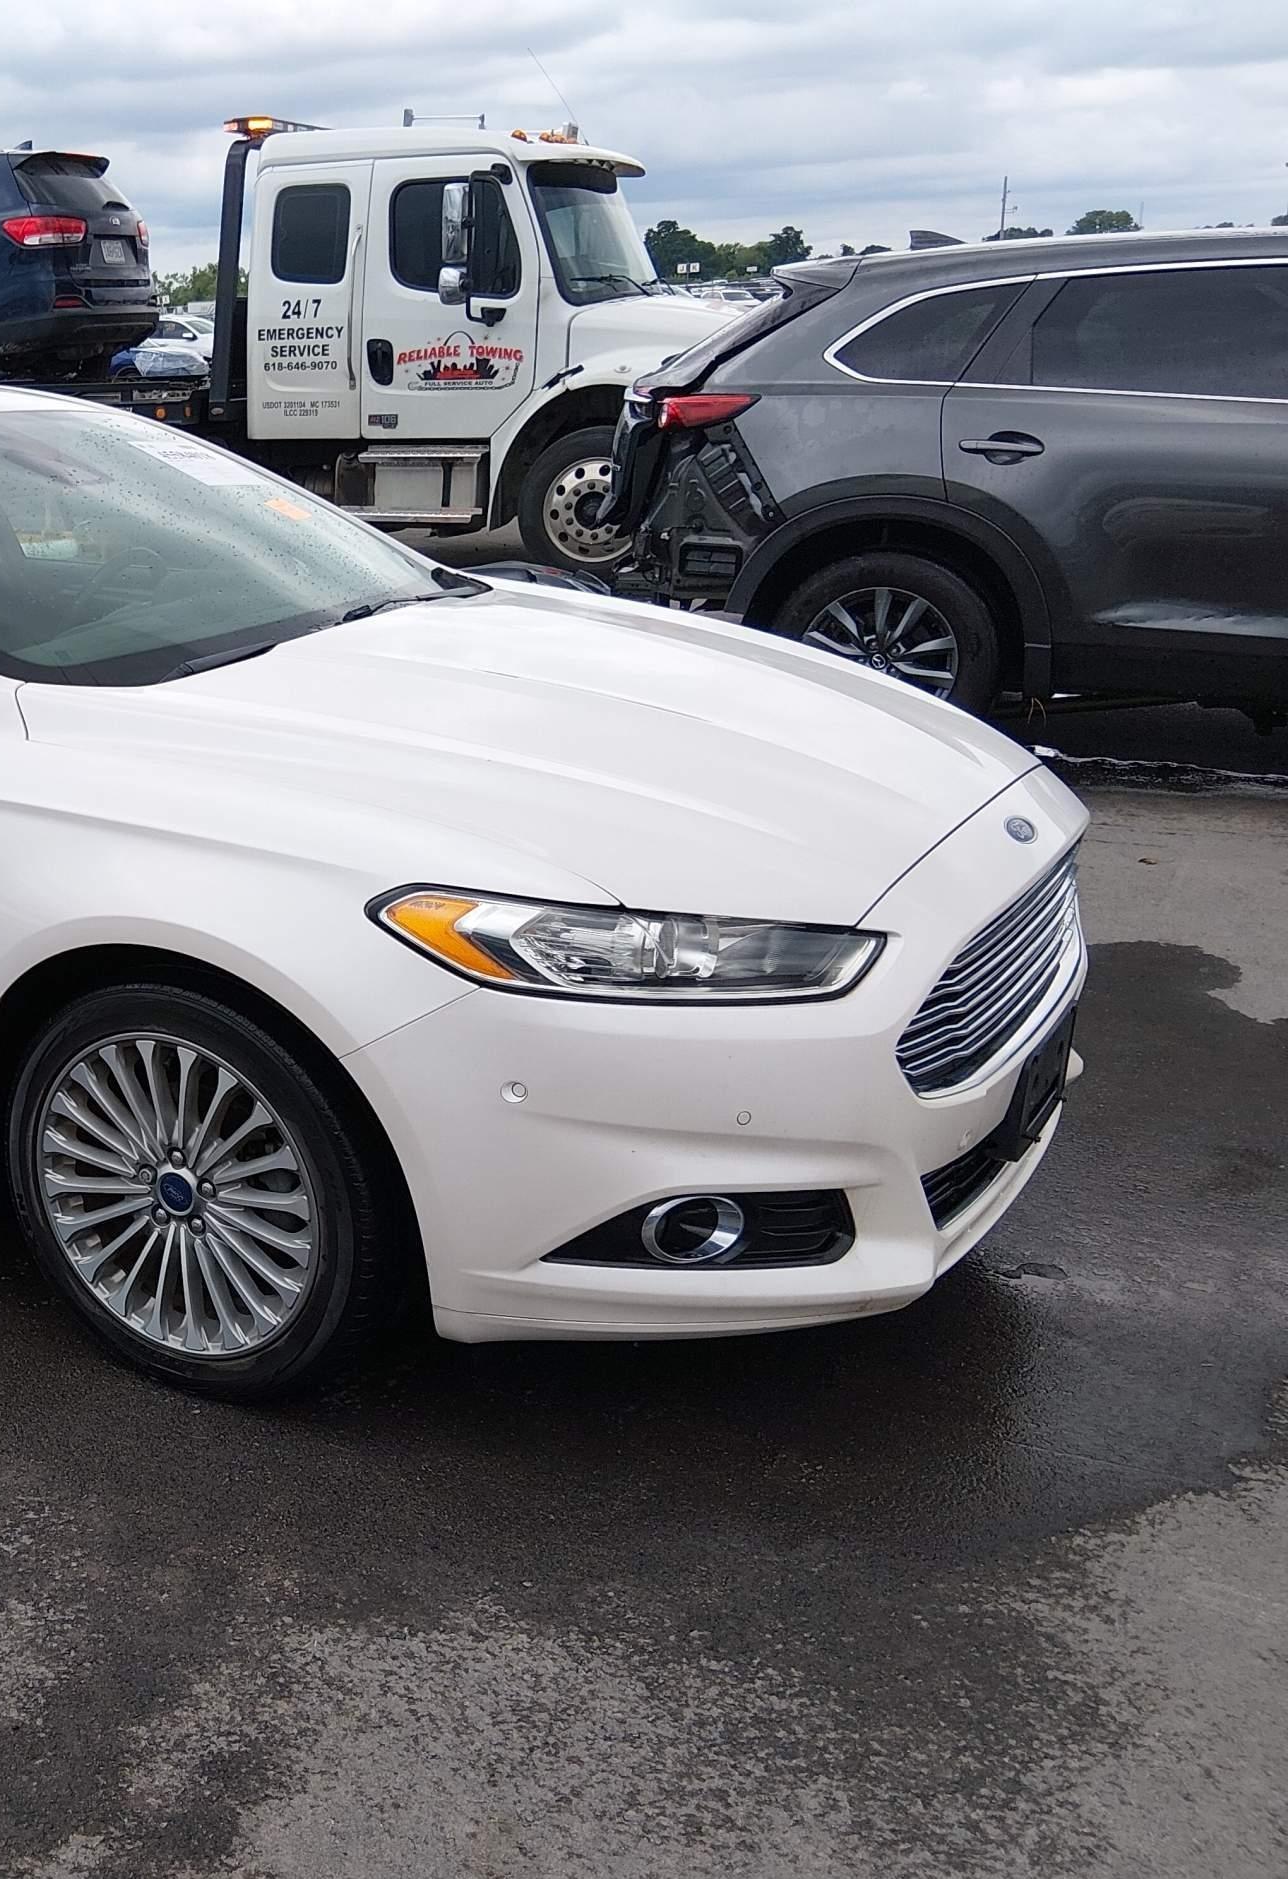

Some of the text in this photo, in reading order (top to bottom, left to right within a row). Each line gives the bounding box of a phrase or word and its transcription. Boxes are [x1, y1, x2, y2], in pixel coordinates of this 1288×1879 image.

[281, 298, 322, 319] 24/7
[258, 326, 344, 341] EMERGENCY
[270, 344, 330, 358] SERVICE
[396, 345, 524, 366] RELIABLE TOWING
[264, 360, 338, 372] 618-646-9070
[263, 401, 282, 409] USDOT
[310, 400, 320, 408] MC
